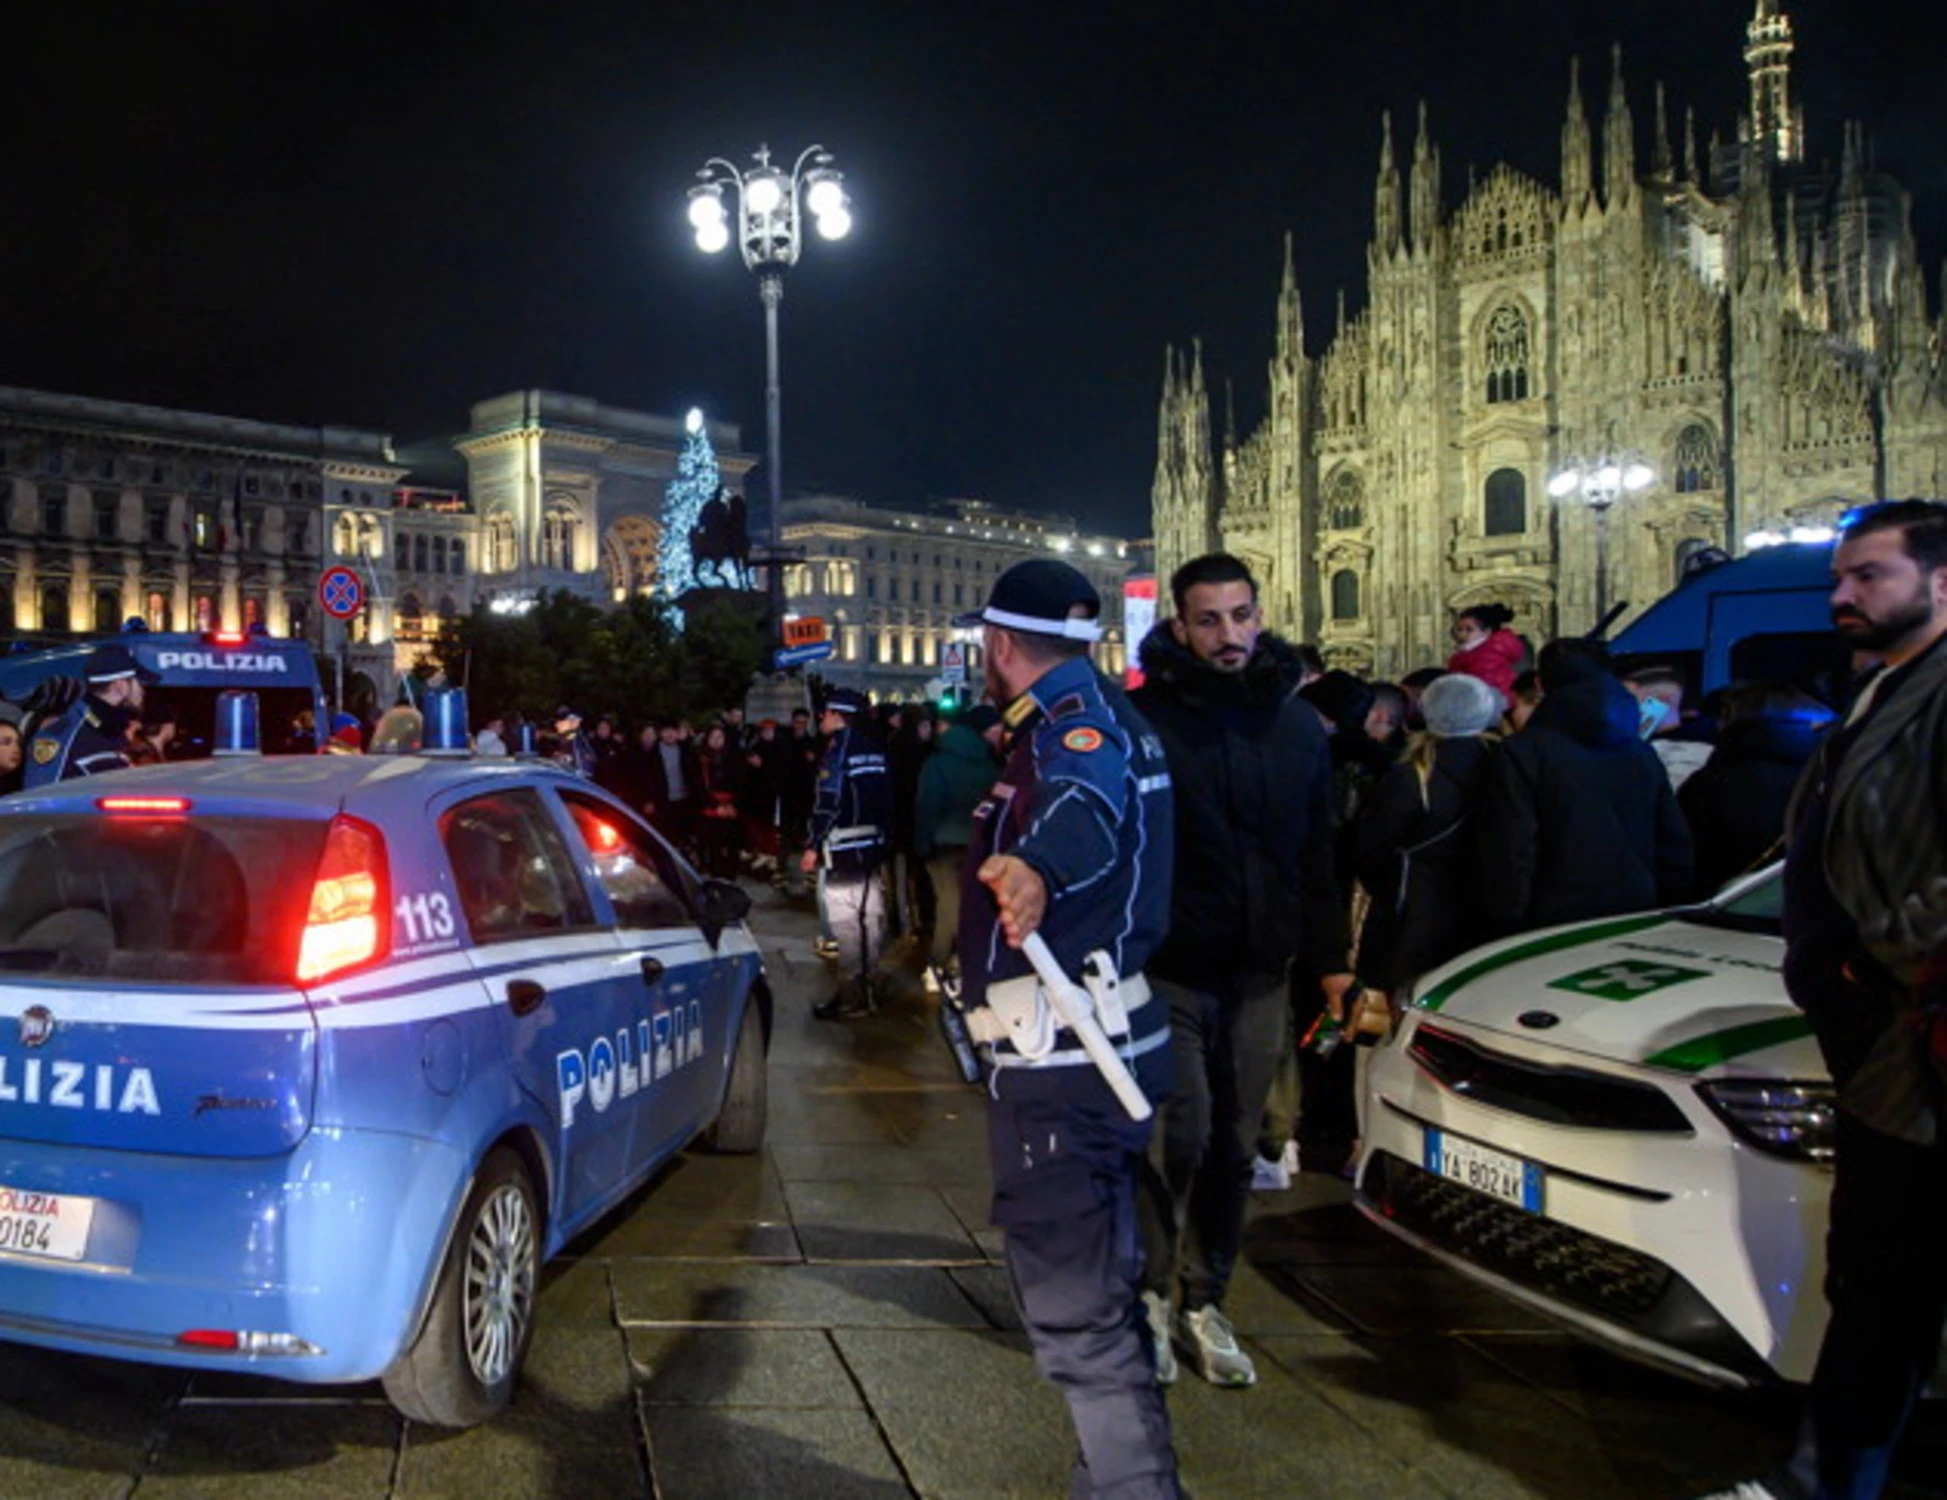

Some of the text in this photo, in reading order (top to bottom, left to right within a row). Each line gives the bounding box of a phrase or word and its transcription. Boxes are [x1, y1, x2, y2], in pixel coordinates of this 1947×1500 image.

[157, 652, 287, 672] POLIZIA
[395, 892, 454, 942] 113
[556, 998, 703, 1129] POLIZIA
